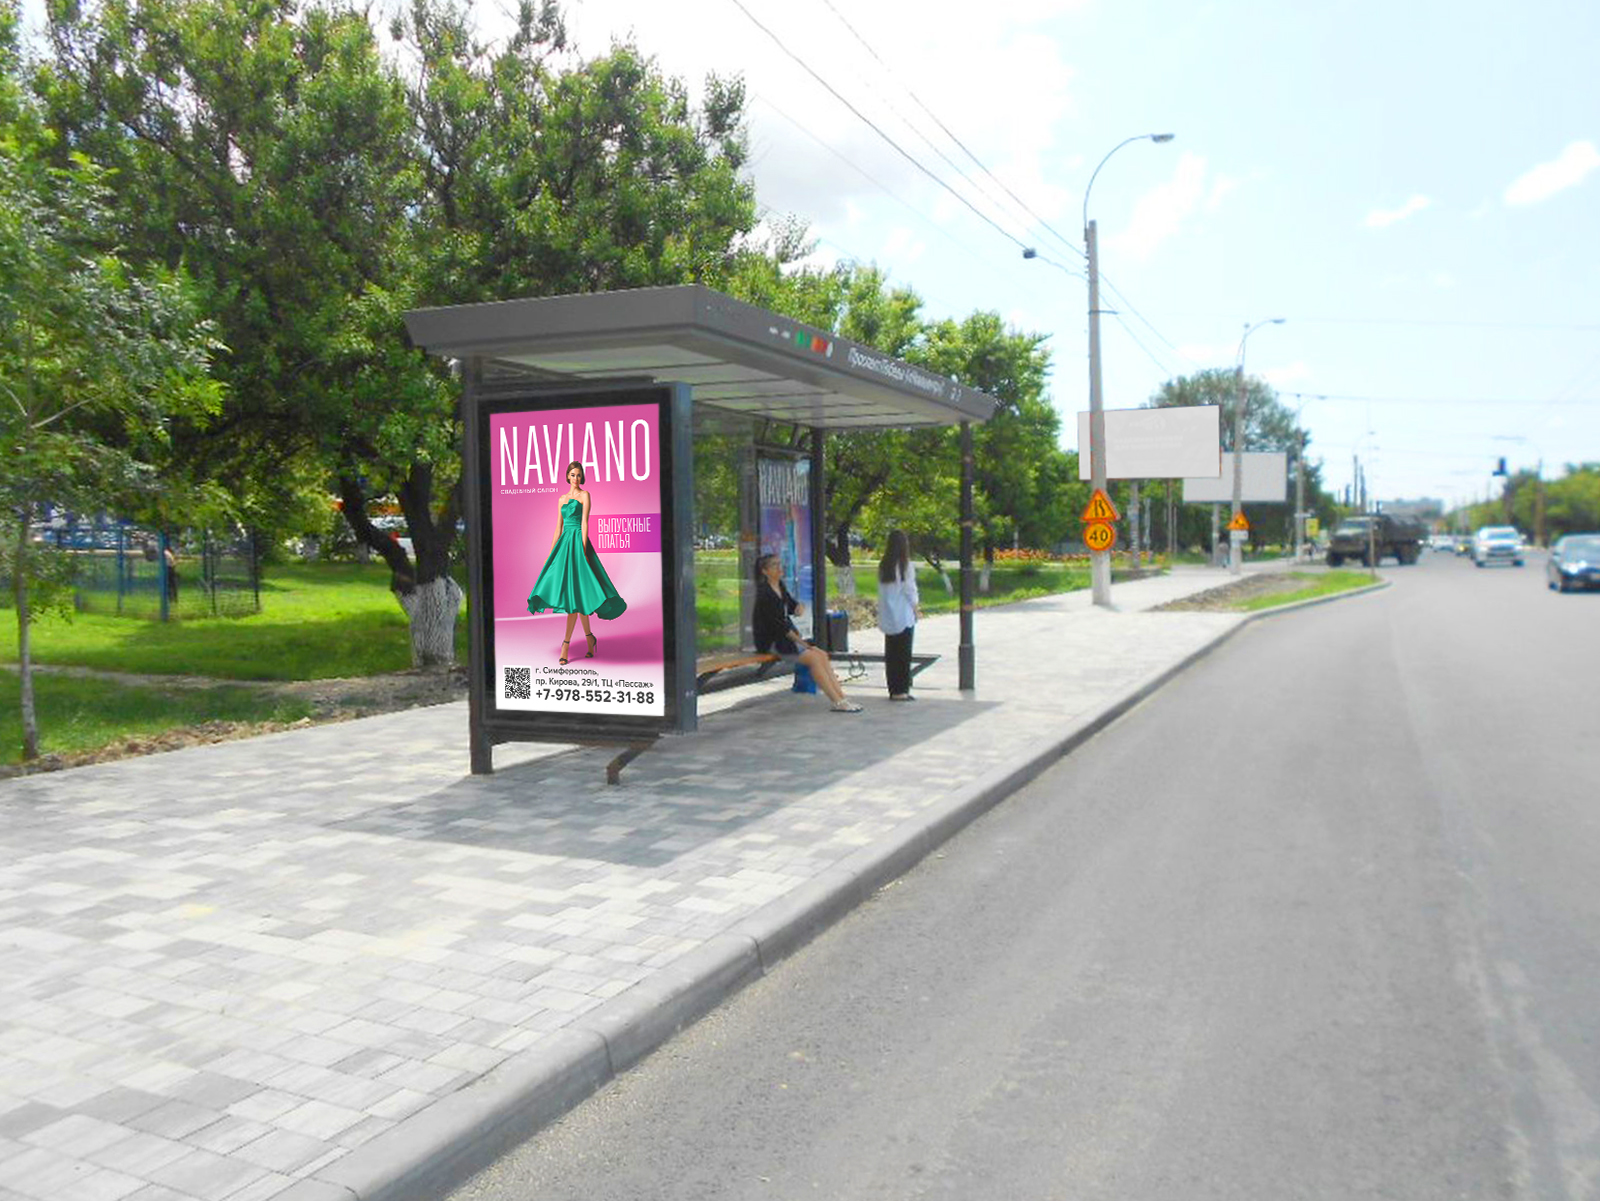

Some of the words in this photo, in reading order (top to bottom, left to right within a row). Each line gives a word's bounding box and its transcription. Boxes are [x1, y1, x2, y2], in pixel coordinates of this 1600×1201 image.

[500, 419, 651, 485] NAVIANO
[537, 486, 559, 494] САЛОН
[597, 517, 652, 533] ВЫПУСКНЫЕ
[598, 534, 631, 549] ПЛАТЬЯ
[1089, 529, 1109, 542] 40
[543, 667, 599, 676] Симферополь,
[535, 679, 548, 687] пр.
[549, 678, 580, 687] Кирова,
[581, 679, 600, 688] 29/1,
[601, 679, 613, 688] ТЦ
[615, 680, 654, 688] «Пассаж»
[536, 689, 654, 704] +7-978-552-31-88
